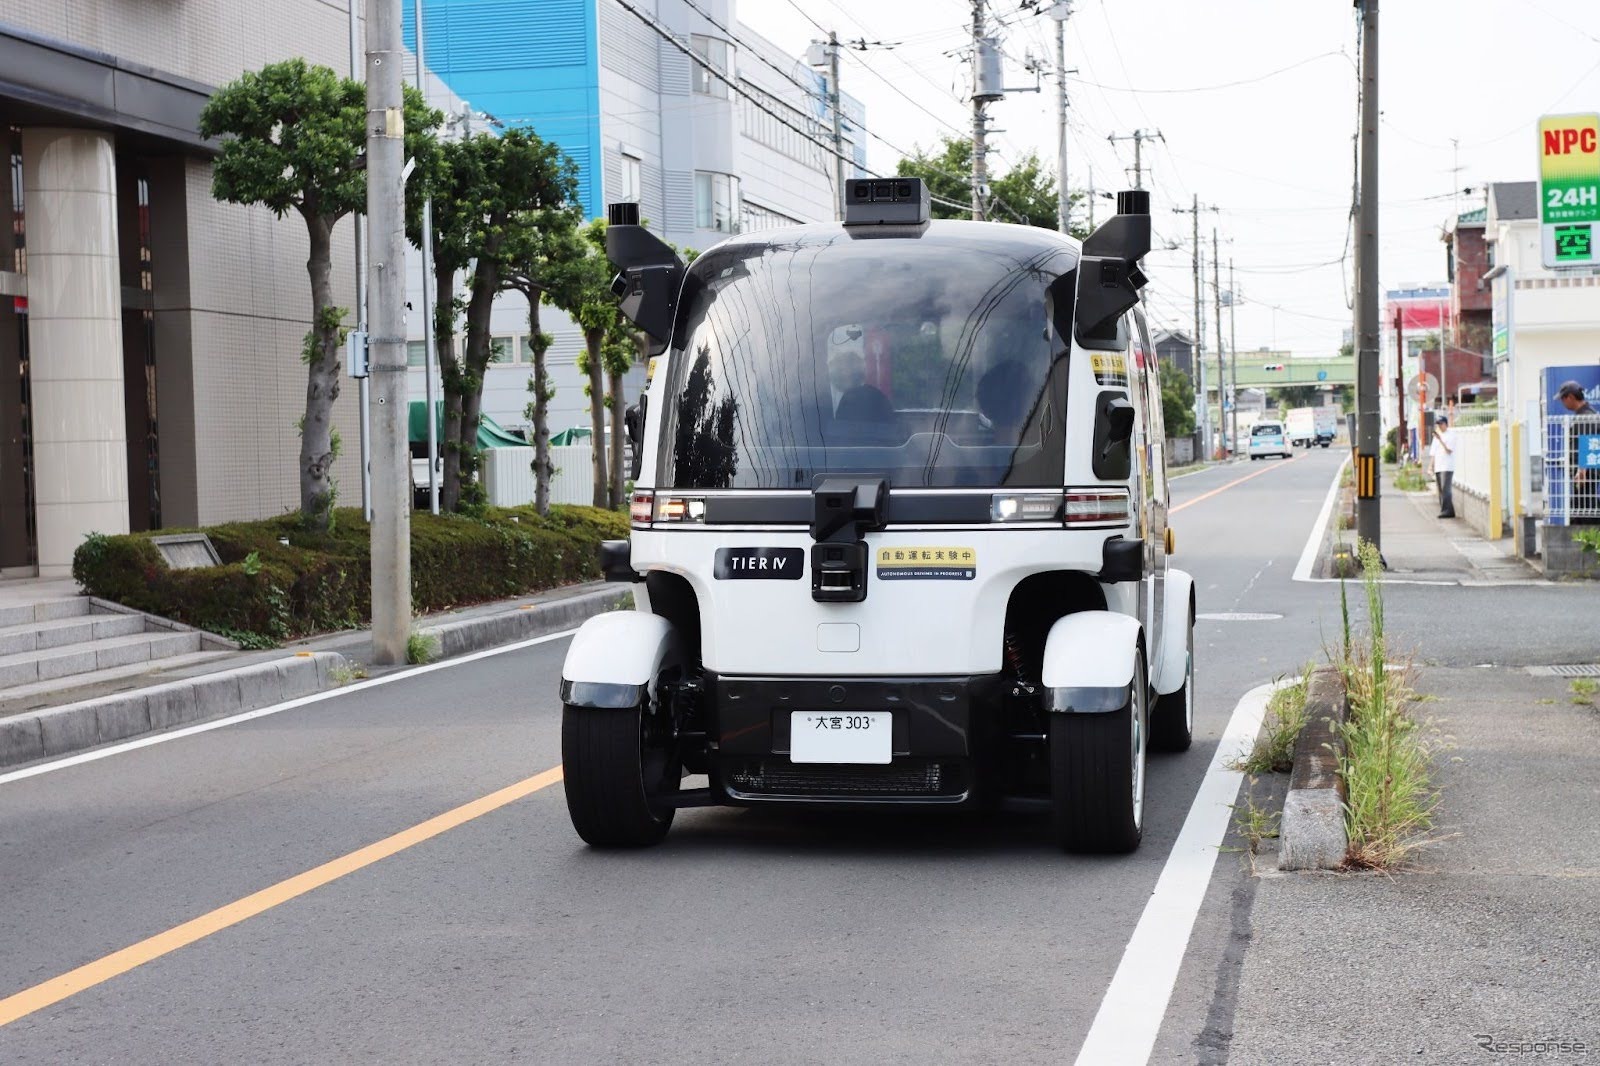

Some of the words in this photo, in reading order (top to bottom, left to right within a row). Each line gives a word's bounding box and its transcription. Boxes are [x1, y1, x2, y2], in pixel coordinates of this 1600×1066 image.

[1543, 127, 1597, 156] NPC
[1547, 185, 1597, 208] 24H
[1555, 224, 1592, 261] 空
[731, 557, 768, 570] TIER
[773, 557, 787, 570] IV
[882, 550, 971, 561] 自動運転実験中
[815, 716, 843, 730] 大宮
[845, 716, 870, 730] 303
